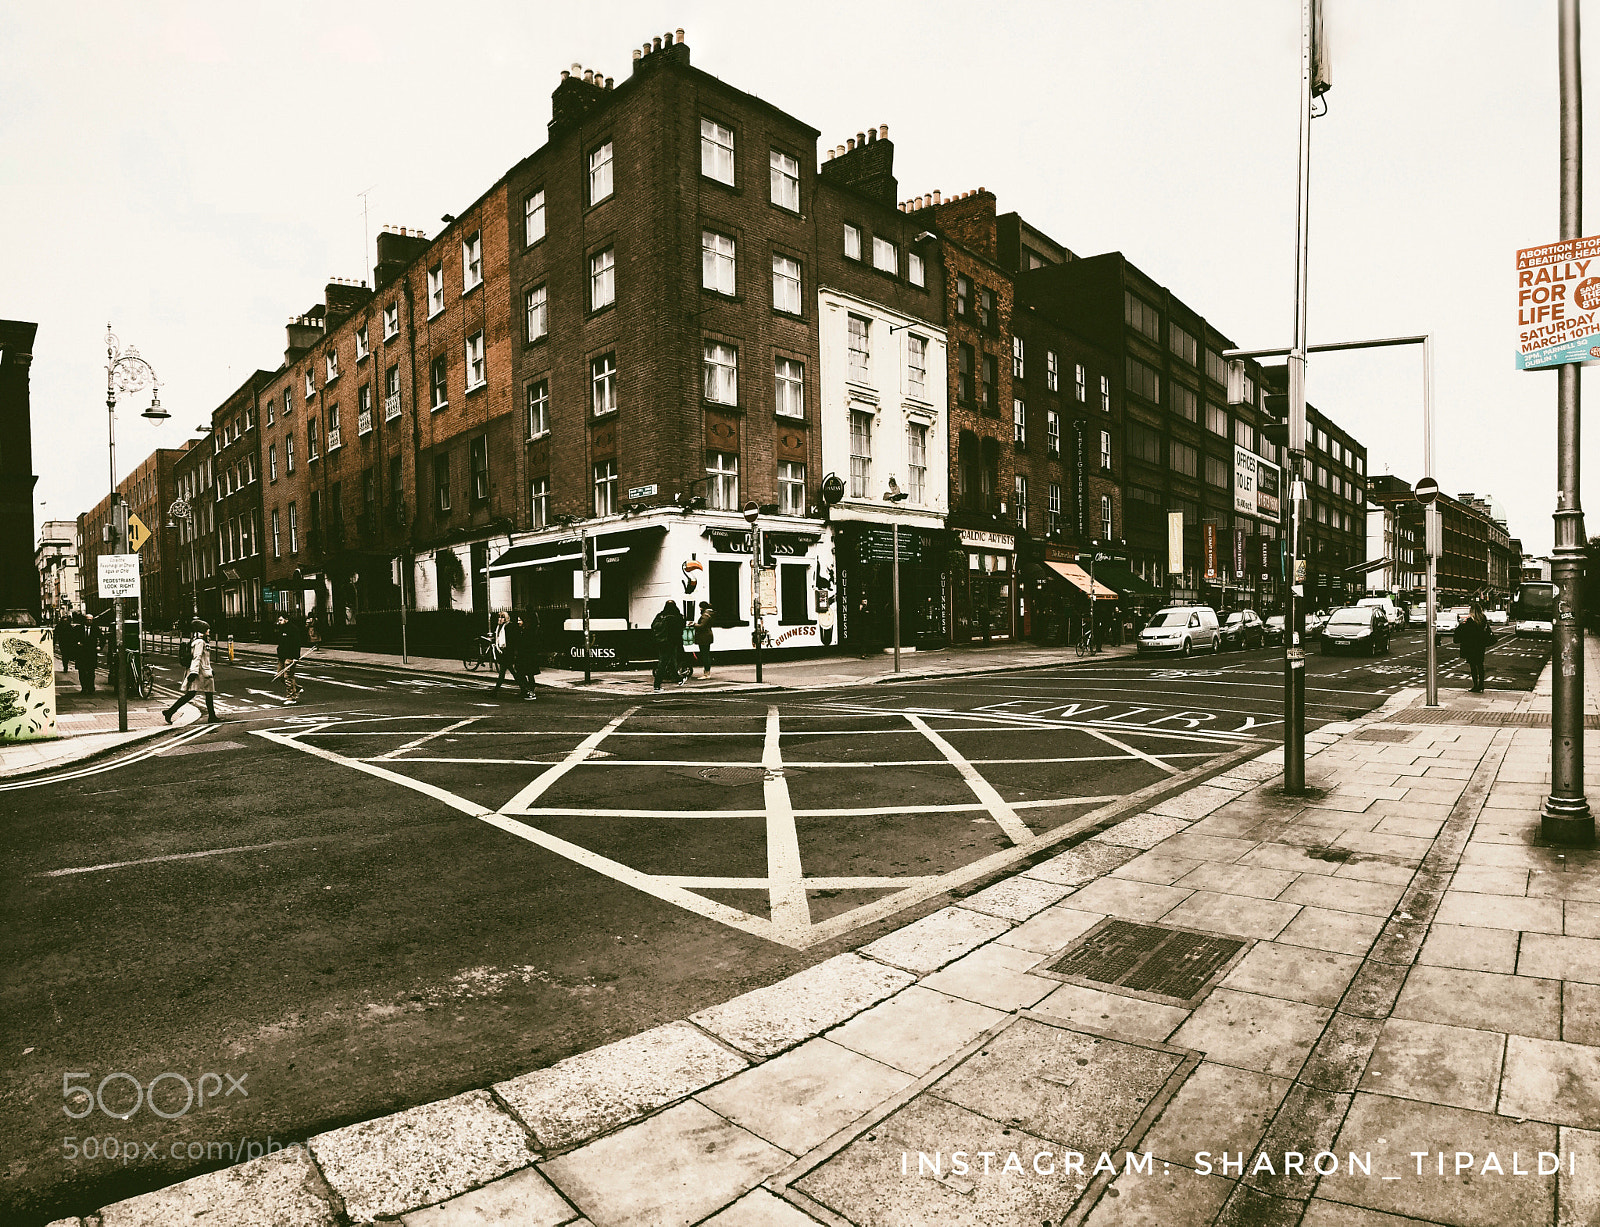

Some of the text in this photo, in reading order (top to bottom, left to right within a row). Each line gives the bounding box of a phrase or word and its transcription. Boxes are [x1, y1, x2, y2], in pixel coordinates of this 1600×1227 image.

[1518, 260, 1526, 269] A
[1528, 251, 1572, 267] BEATING
[1519, 242, 1573, 260] ABORTION
[1519, 260, 1592, 288] RALLY
[1519, 284, 1566, 306] FOR
[1519, 303, 1565, 326] LIFE
[1520, 312, 1595, 342] SATURDAY
[1521, 323, 1600, 353] MARCH 10TH
[1543, 343, 1576, 356] PARNELL
[1576, 339, 1588, 347] SQ
[1525, 356, 1552, 368] DUBLIN
[1236, 450, 1256, 473] OFFICES
[1236, 472, 1252, 492] TO LET
[729, 540, 795, 555] GUESS
[960, 530, 1014, 546] RALDIC ARTISTS
[775, 626, 817, 646] GUINNESS
[570, 646, 616, 658] GUINESS
[971, 700, 1285, 734] ENTRY
